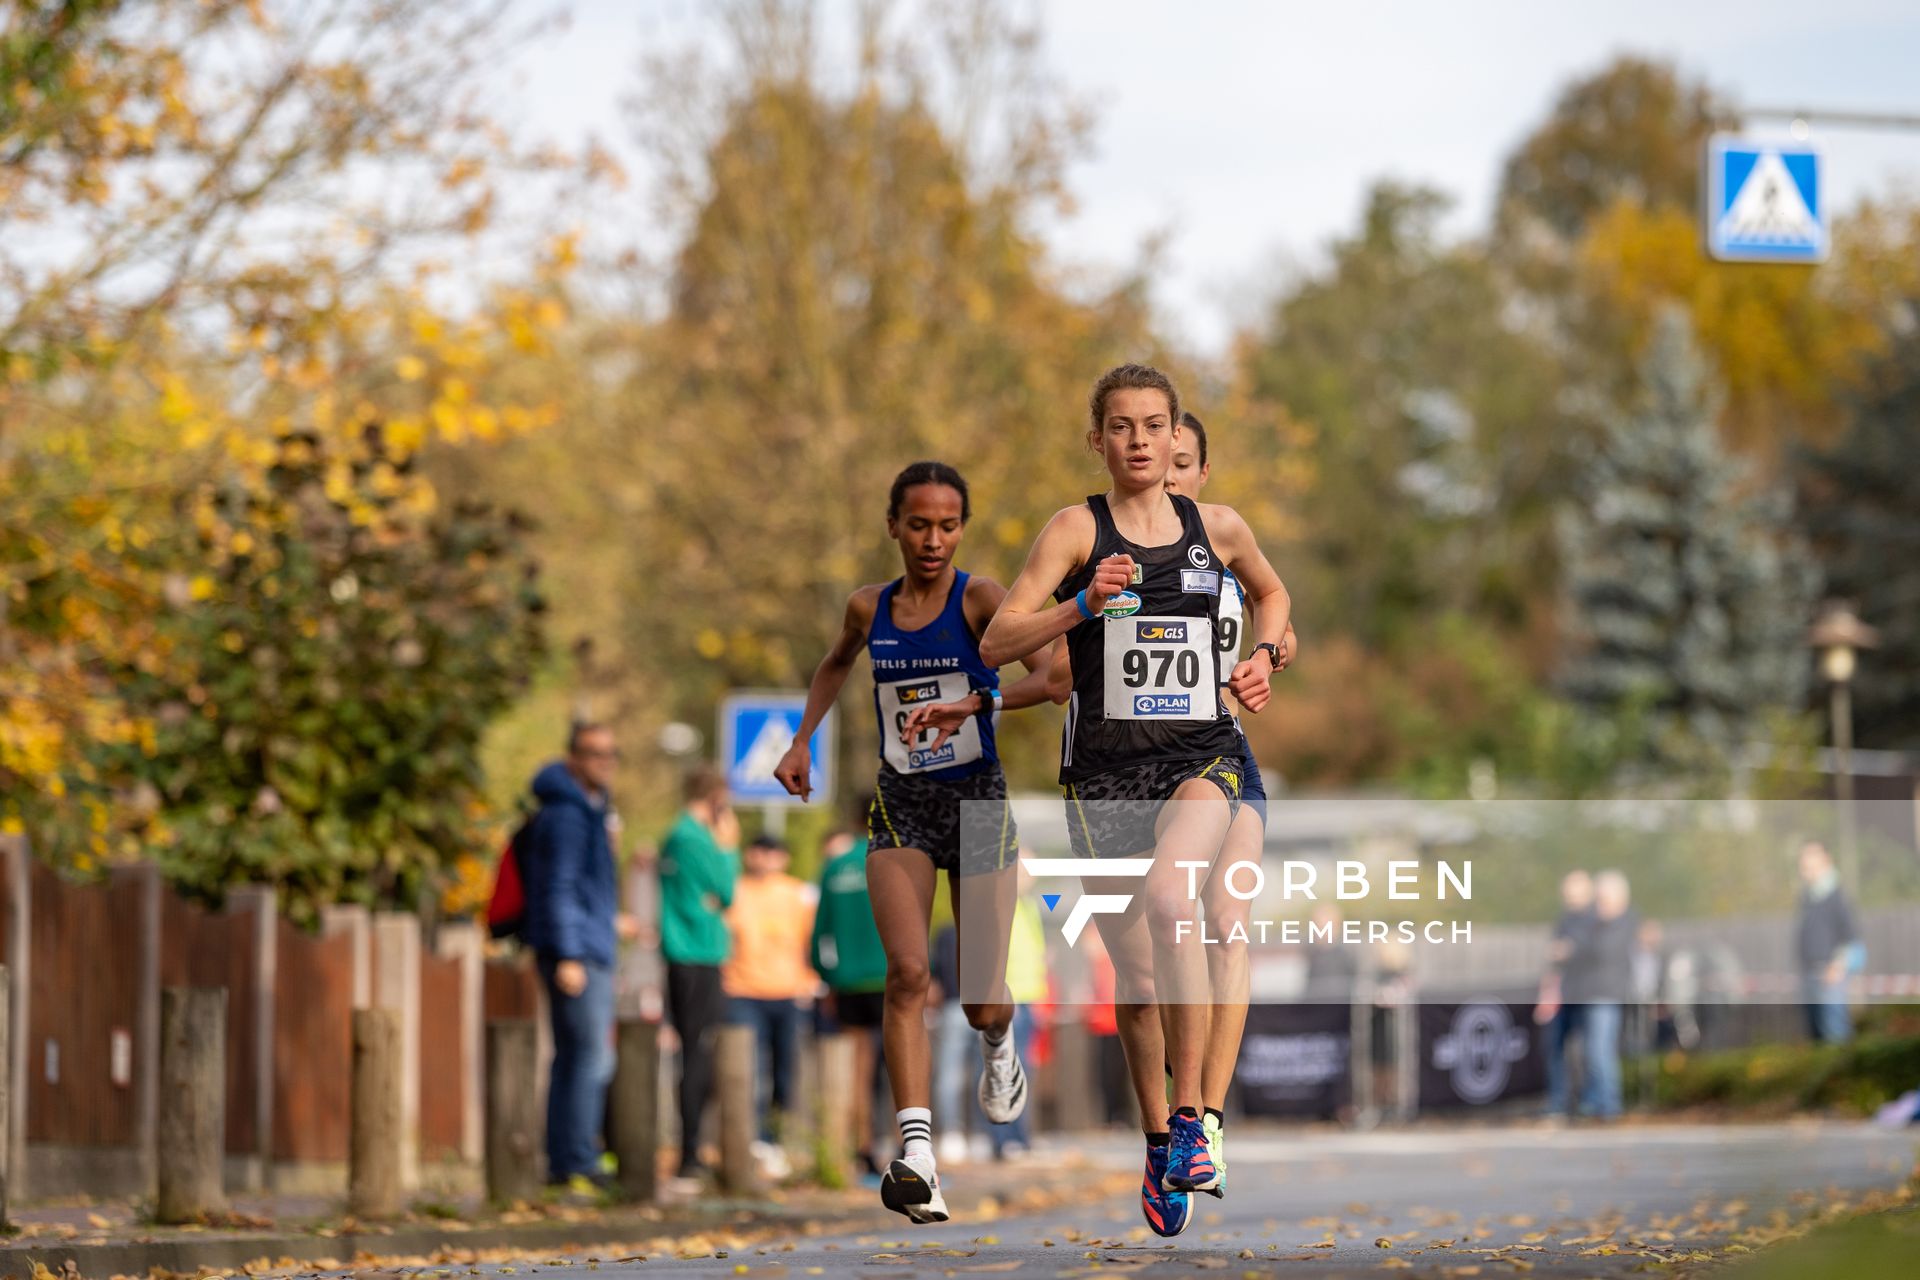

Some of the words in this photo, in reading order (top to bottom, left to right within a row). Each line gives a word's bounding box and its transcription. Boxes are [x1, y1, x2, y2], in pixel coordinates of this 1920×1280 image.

[1164, 627, 1184, 639] GLS
[912, 657, 959, 669] FINANZ
[1123, 649, 1200, 688] 970
[917, 686, 937, 699] GLS
[1157, 698, 1188, 708] PLAN
